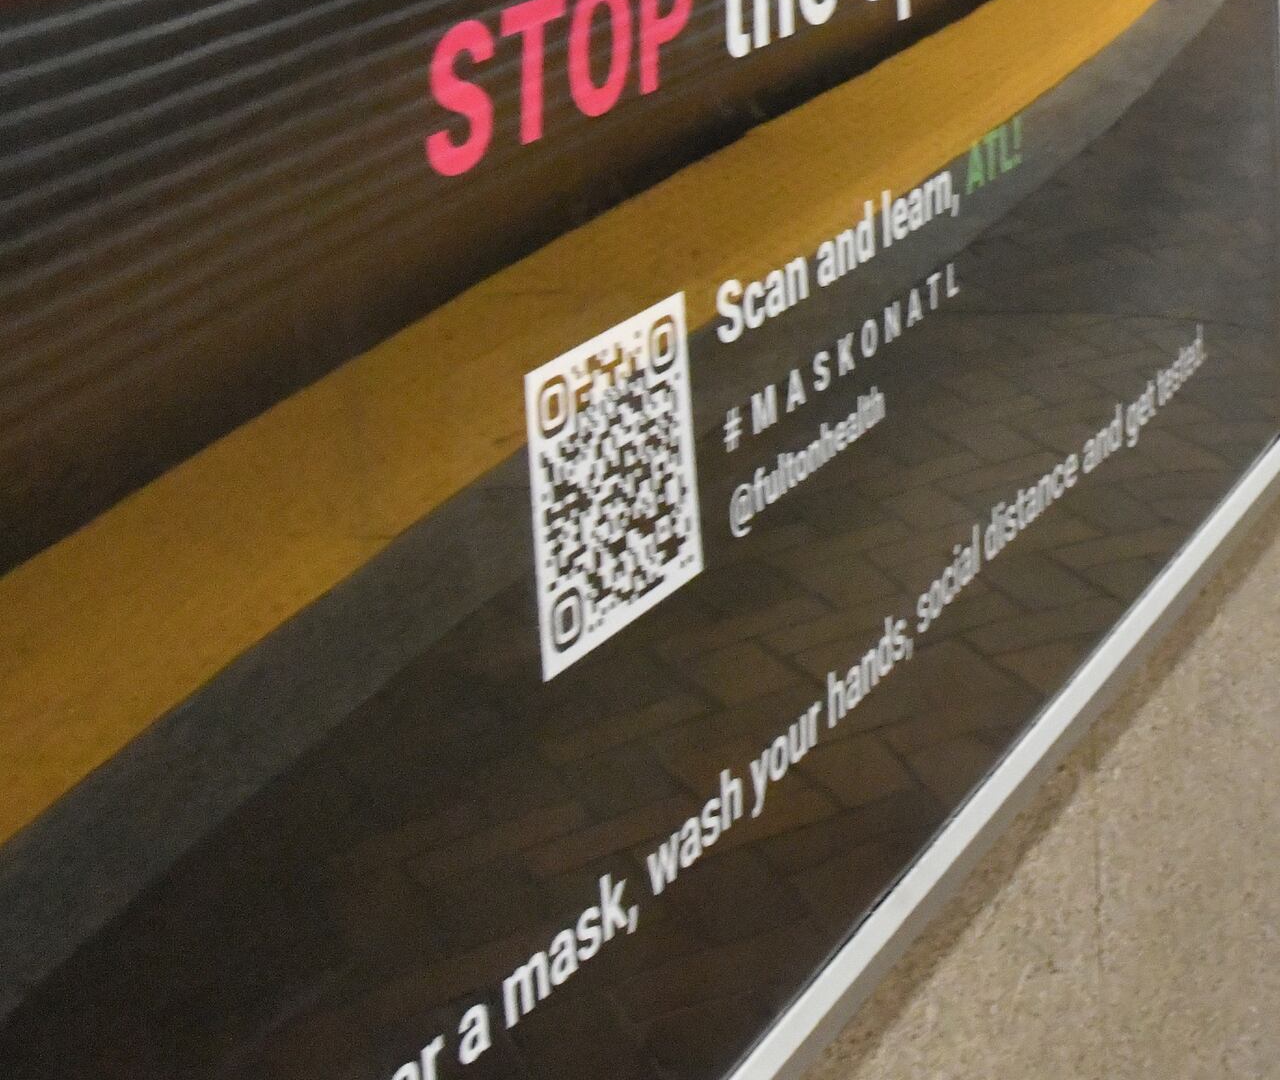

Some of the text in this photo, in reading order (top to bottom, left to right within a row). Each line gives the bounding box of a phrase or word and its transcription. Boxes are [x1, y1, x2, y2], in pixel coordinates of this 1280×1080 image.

[716, 118, 1023, 344] Scan and learn, ATL!
[729, 385, 887, 538] @fultonhealth
[458, 1003, 492, 1065] a
[502, 873, 640, 1030] mask,
[646, 768, 744, 896] wash
[749, 700, 823, 819] your
[827, 615, 914, 729] hands,
[916, 523, 981, 633] social
[983, 453, 1079, 561] distance
[1083, 402, 1123, 474] and
[1126, 379, 1157, 448] get
